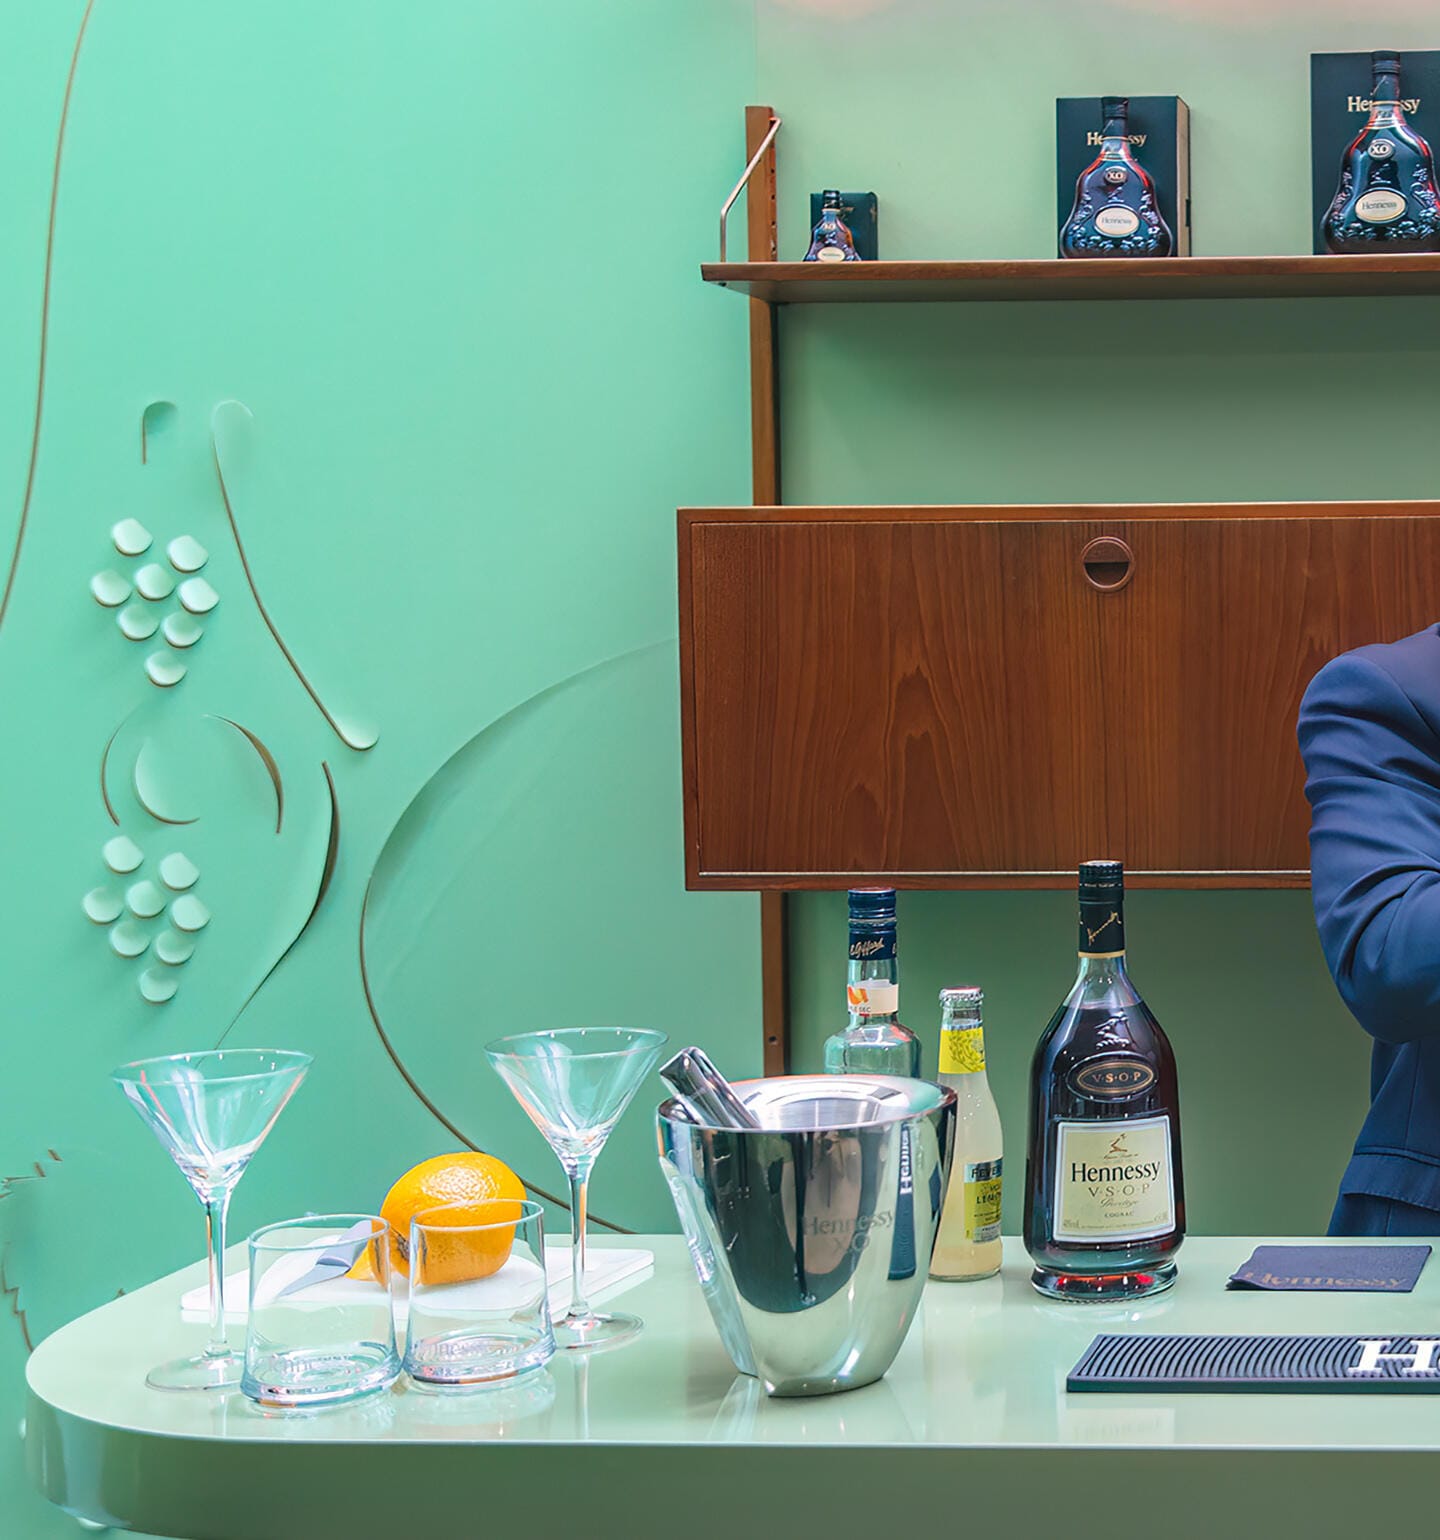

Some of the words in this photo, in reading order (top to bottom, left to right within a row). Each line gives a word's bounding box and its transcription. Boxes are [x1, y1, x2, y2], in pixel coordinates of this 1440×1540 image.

[1346, 95, 1421, 114] Hessy
[1086, 131, 1148, 147] Hessy
[1071, 1160, 1161, 1183] Hennessy
